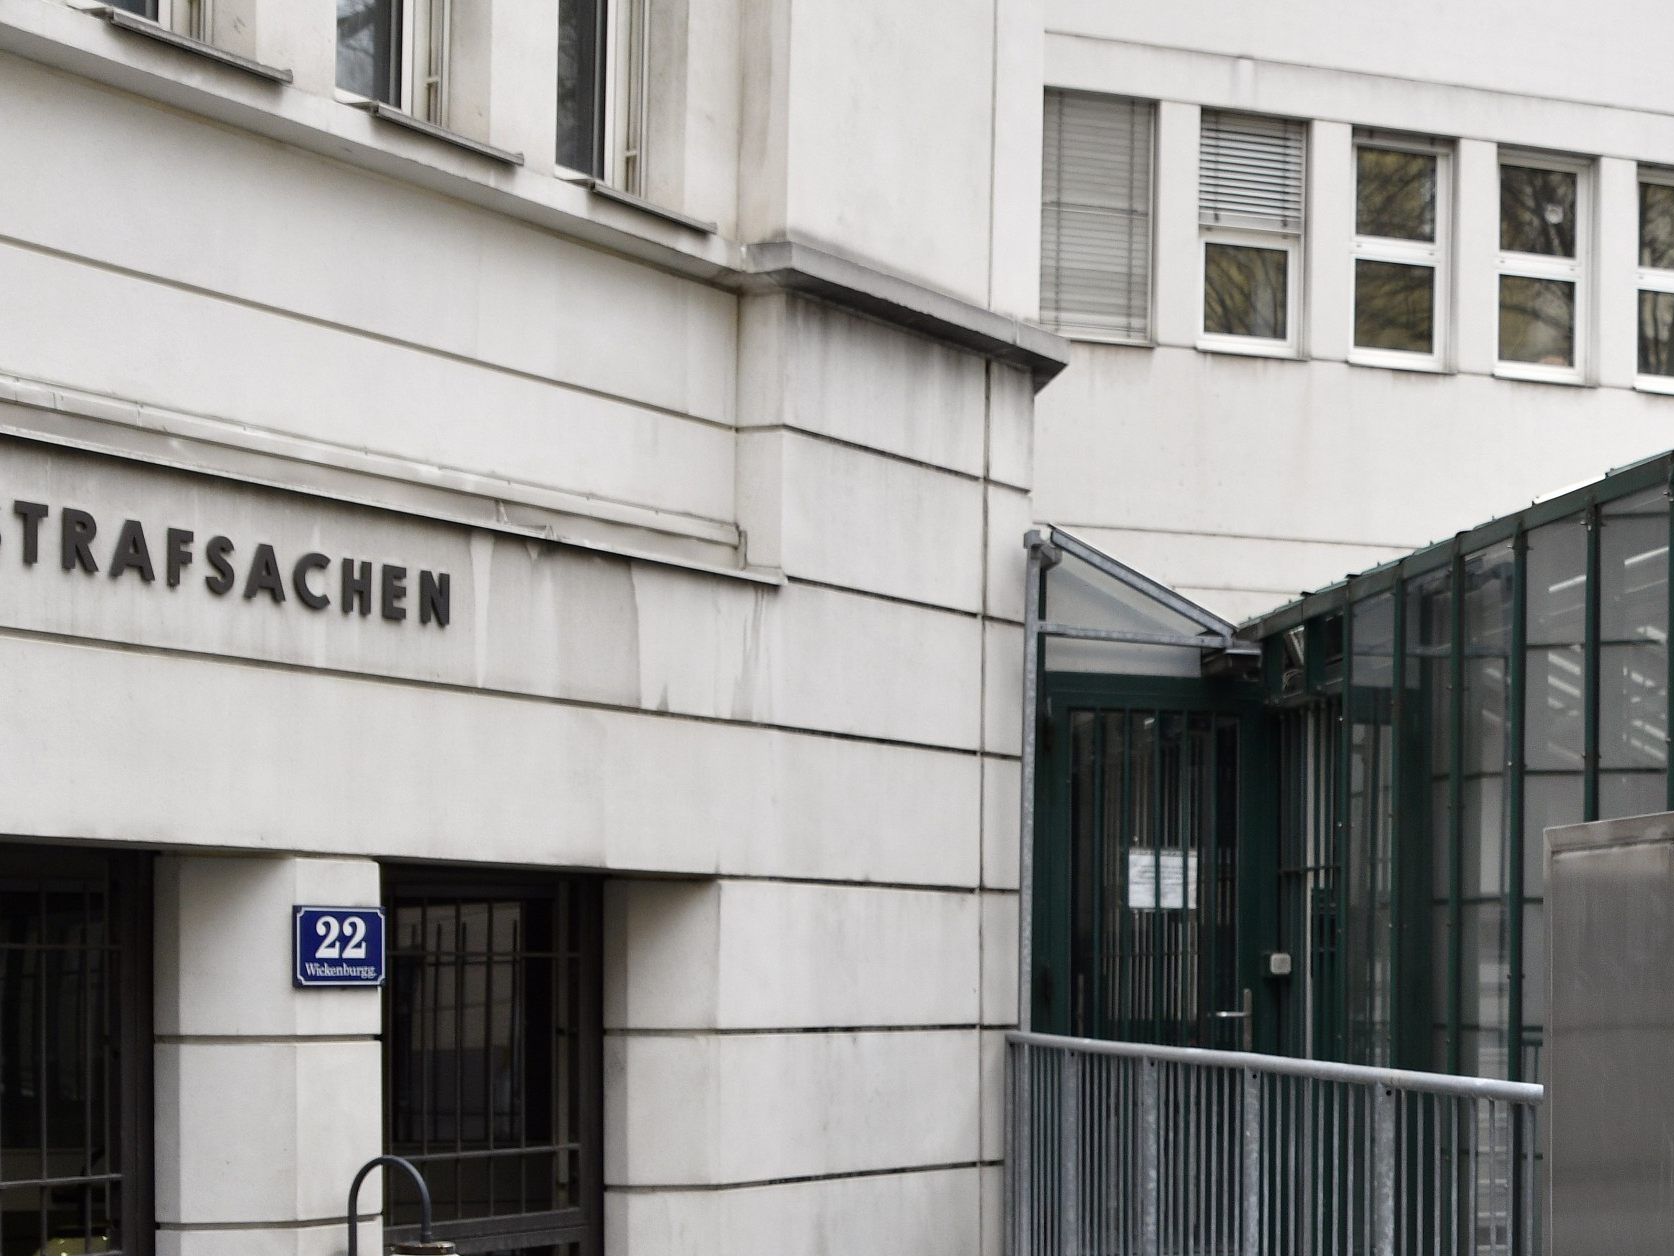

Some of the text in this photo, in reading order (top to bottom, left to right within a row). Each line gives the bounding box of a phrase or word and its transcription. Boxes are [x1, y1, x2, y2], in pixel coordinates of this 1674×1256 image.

[0, 500, 451, 627] TRAFSACHEN
[315, 915, 366, 959] 22
[305, 962, 377, 979] Wickenburgg.
